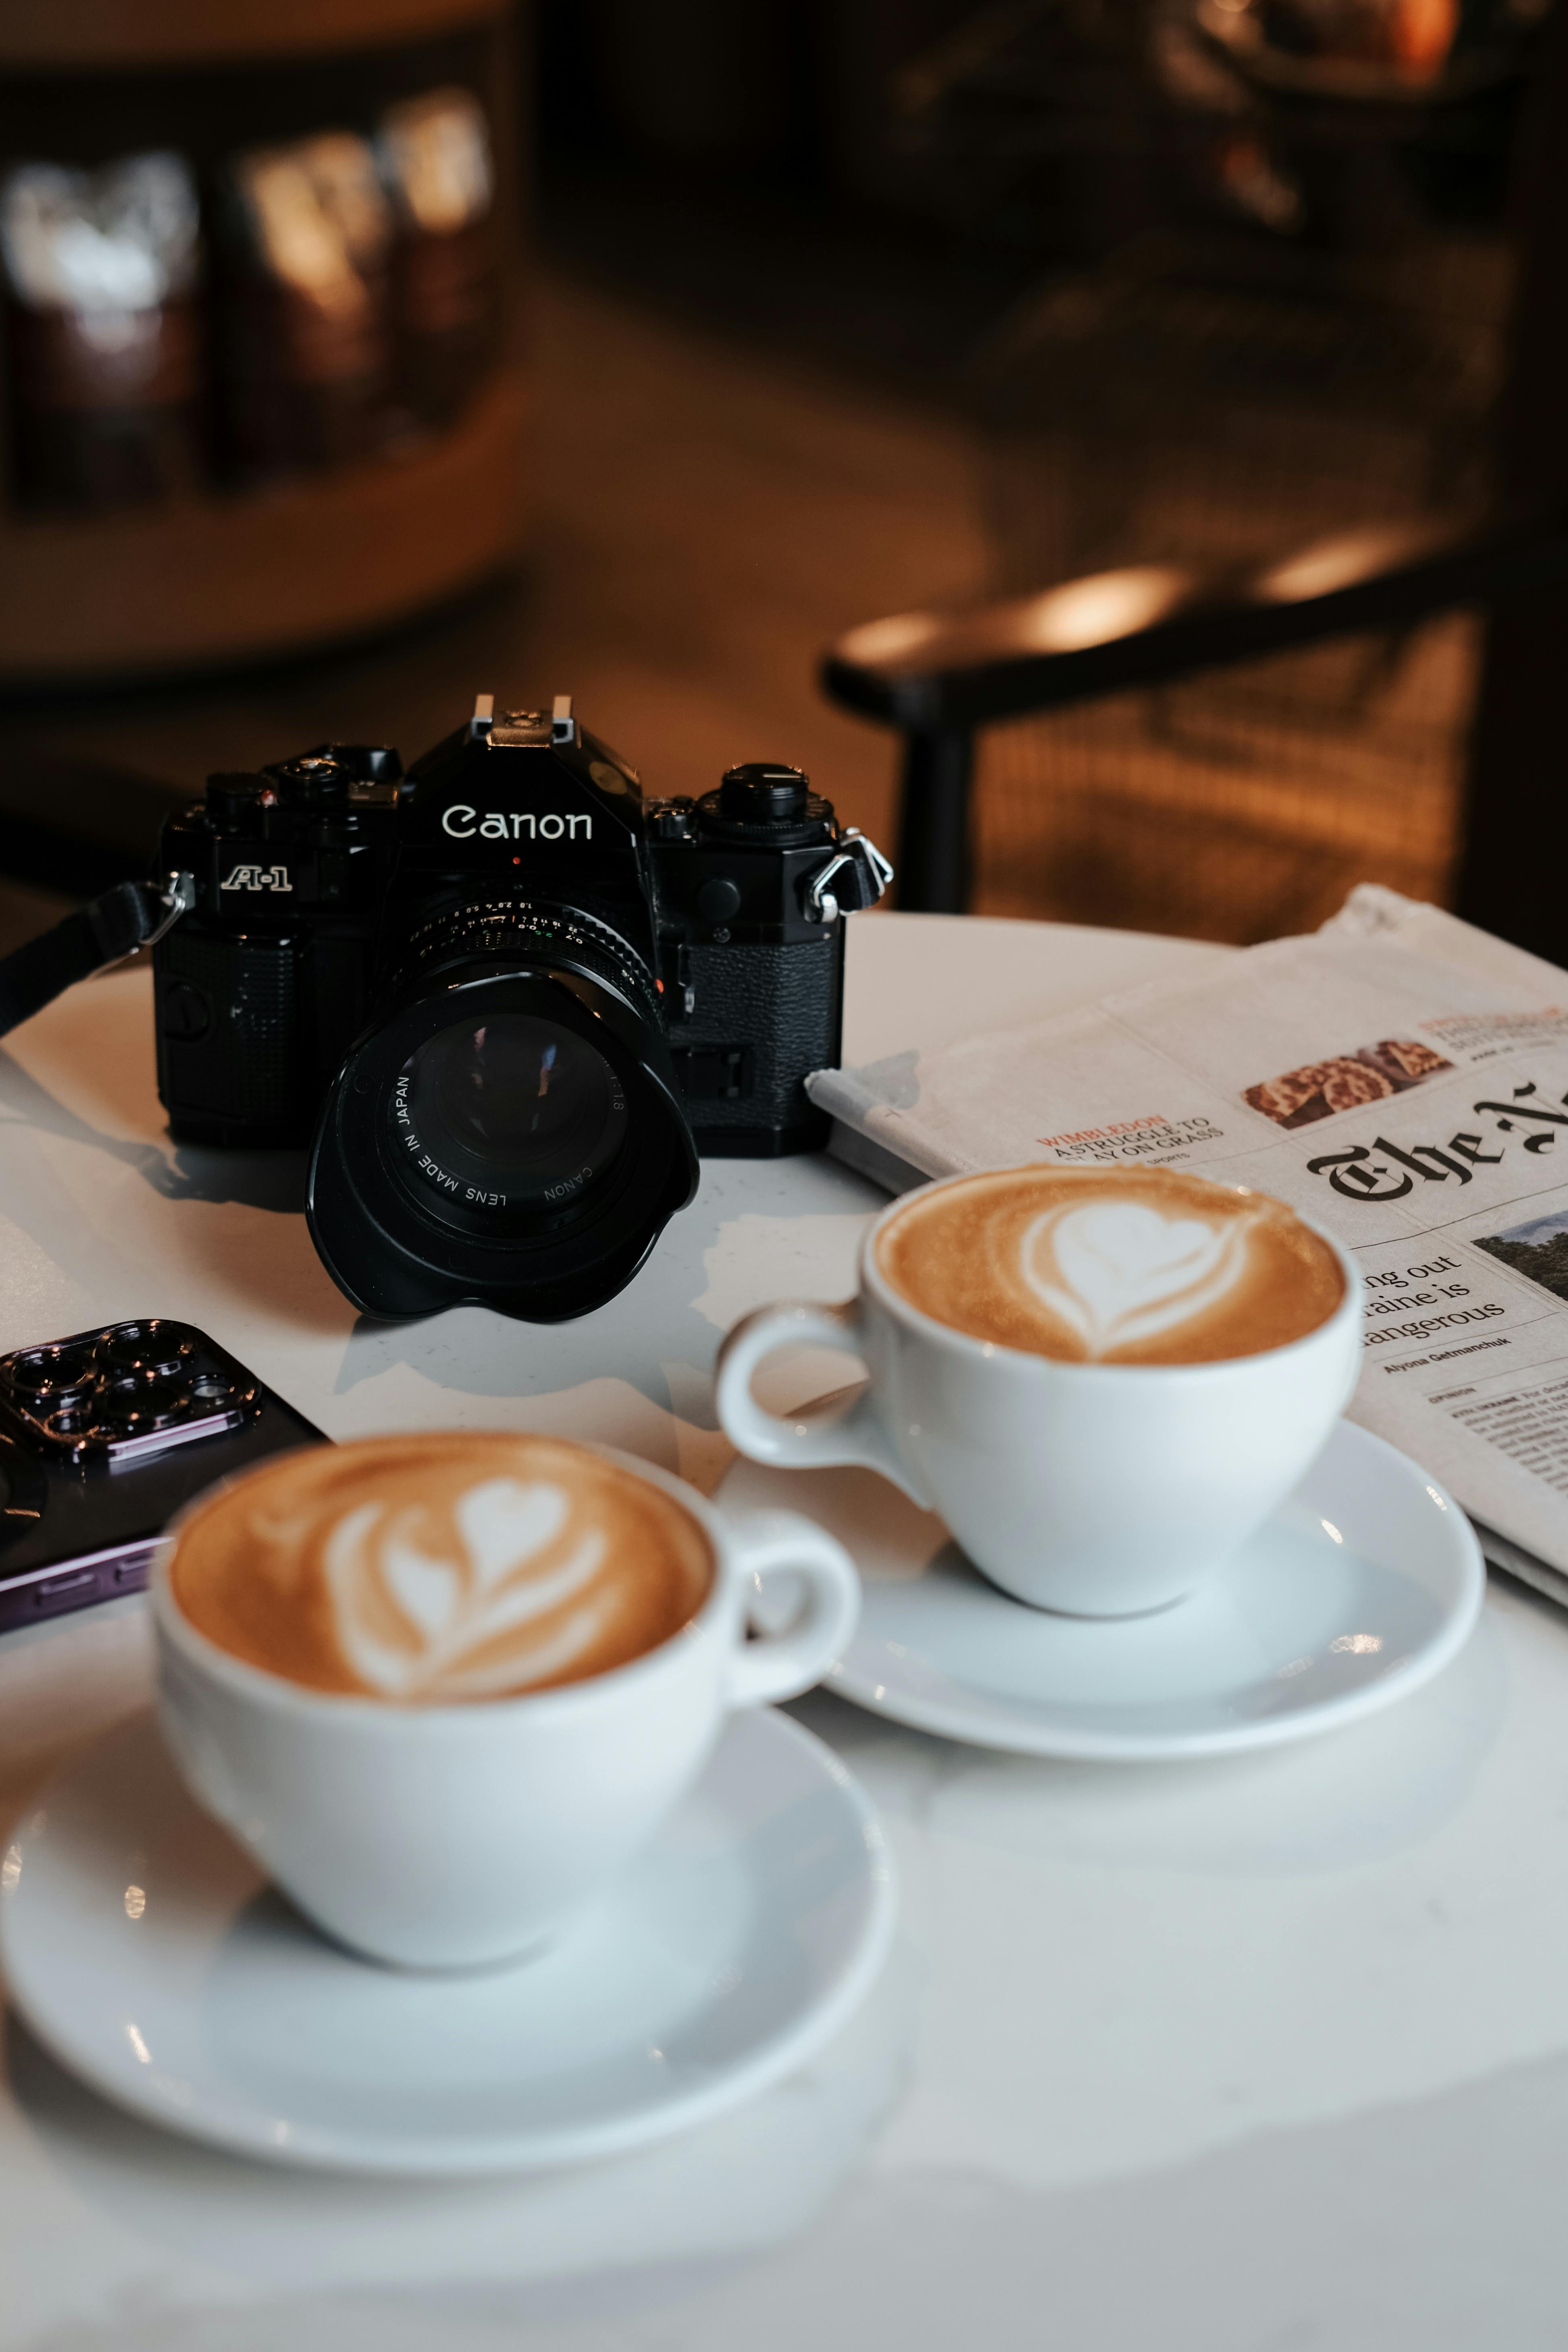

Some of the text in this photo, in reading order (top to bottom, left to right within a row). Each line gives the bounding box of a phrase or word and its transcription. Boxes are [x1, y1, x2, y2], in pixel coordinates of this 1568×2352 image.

[442, 804, 592, 840] Canon
[220, 864, 293, 892] A-1
[565, 935, 583, 944] 0.7
[395, 1076, 506, 1207] LENS MADE IN JAPAN
[1036, 1115, 1168, 1147] WIMBLEDON
[1054, 1117, 1210, 1158] A STRUGGLE TO
[1122, 1143, 1156, 1156] ON
[1156, 1127, 1224, 1148] GRASS
[1147, 1153, 1190, 1165] SPORTS
[1307, 1132, 1505, 1202] The
[545, 1167, 593, 1202] CANON
[1407, 1256, 1462, 1278] out
[1432, 1284, 1470, 1299] is
[1384, 1337, 1512, 1374] Alyona Getmanchuk
